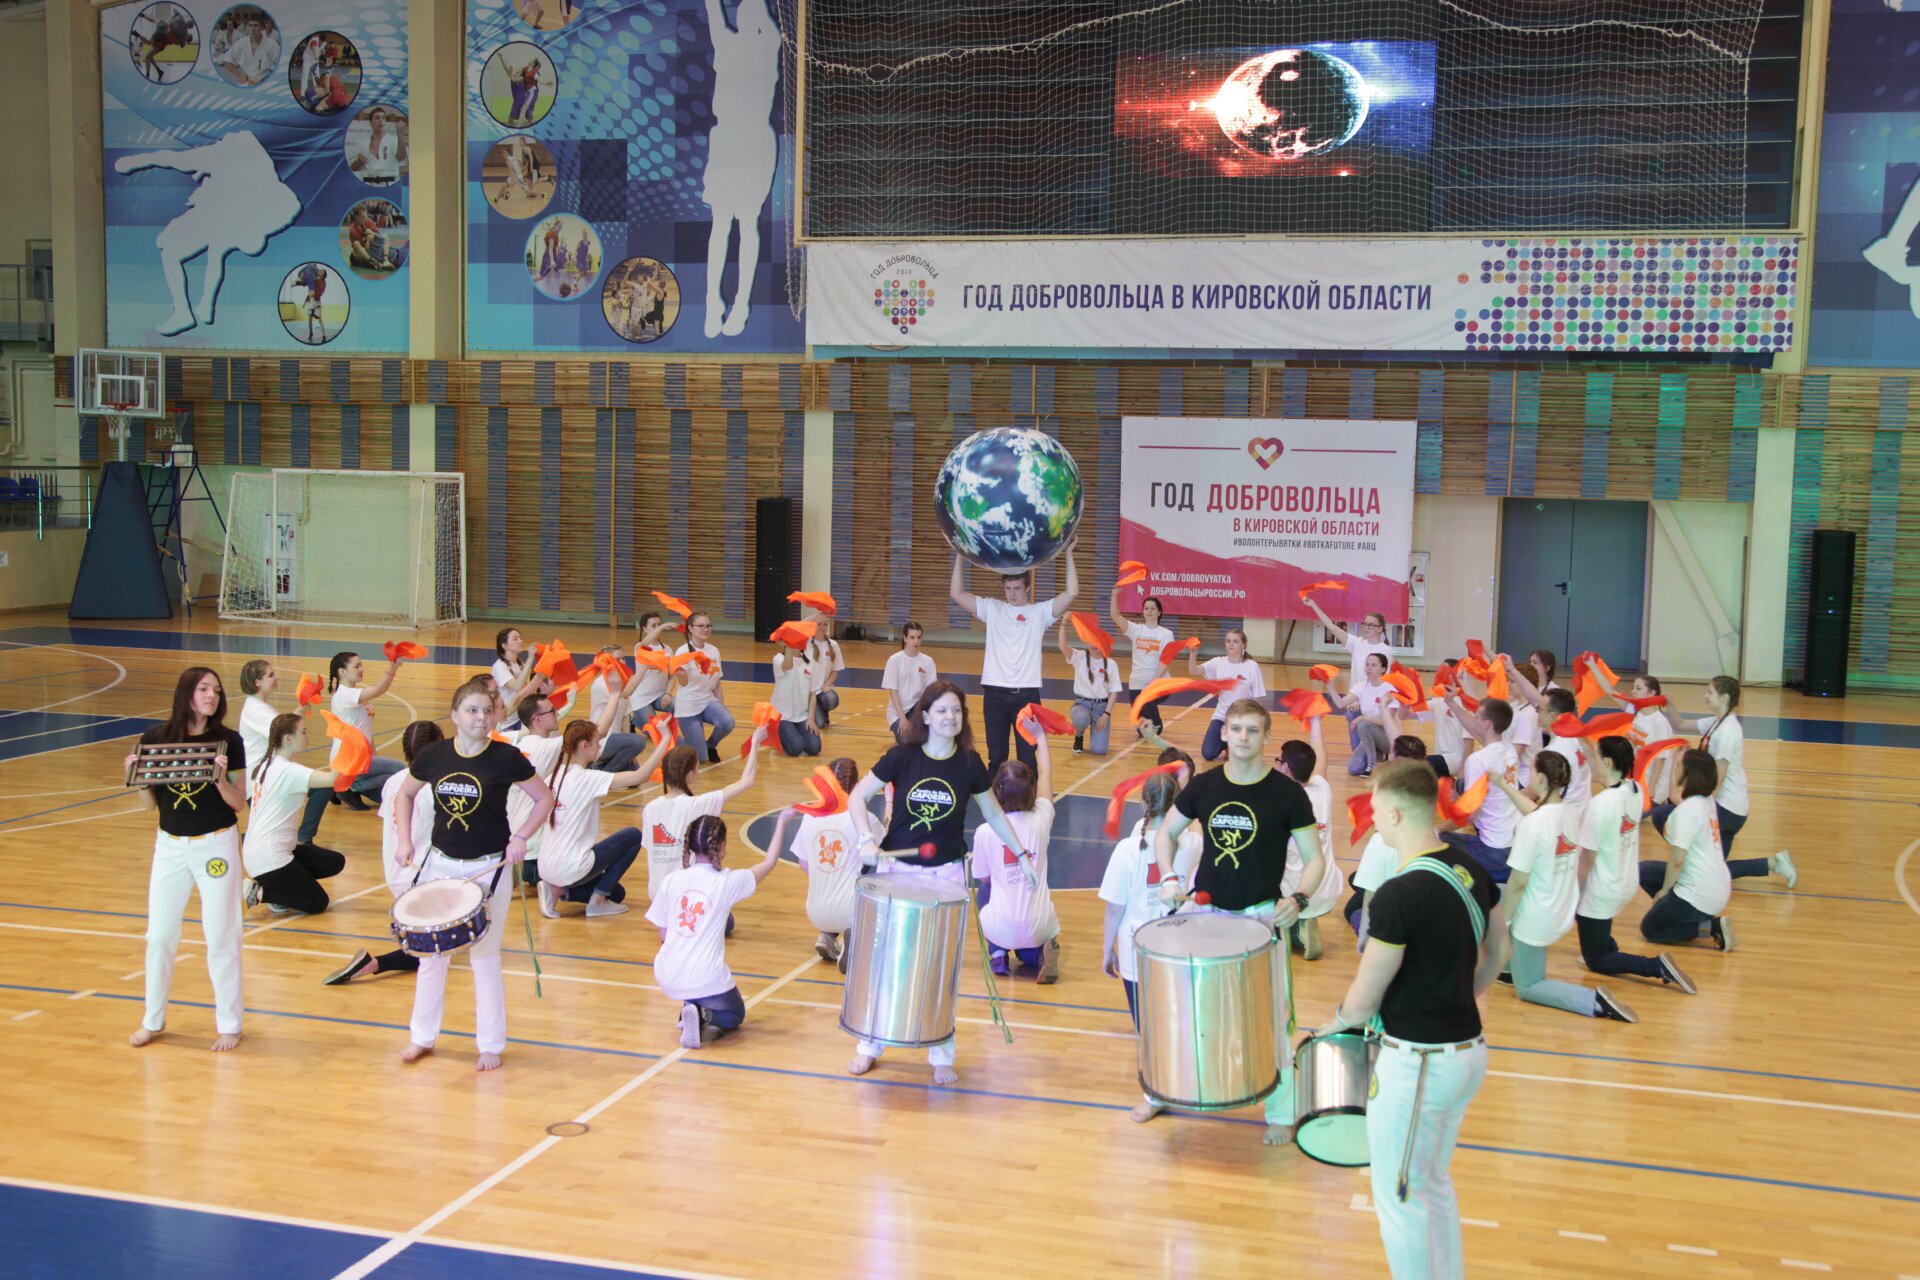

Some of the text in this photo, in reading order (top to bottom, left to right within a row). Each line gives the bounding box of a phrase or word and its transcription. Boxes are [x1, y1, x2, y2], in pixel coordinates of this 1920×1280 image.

[870, 254, 939, 280] ГОД ДОБРОВОЛЬЦА
[963, 280, 1432, 312] ГОД ДОБРОВОЛЬЦА В КИРОВСКОЙ ОБЛАСТИ
[1151, 482, 1380, 517] ГОД ДОБРОВОЛЬЦА
[1233, 517, 1379, 536] В КИРОВСКОЙ ОБЛАСТИ
[1233, 538, 1301, 548] #ВОЛОНТЕРЫВЯТКИ
[1150, 572, 1232, 584] VK.COM/DOBROVYATKA
[1150, 586, 1246, 599] ДОБРОВОЛЬЦЫРОССИИ.РФ
[438, 785, 478, 795] CAPOEIRA
[911, 792, 952, 802] CAPOEIRA
